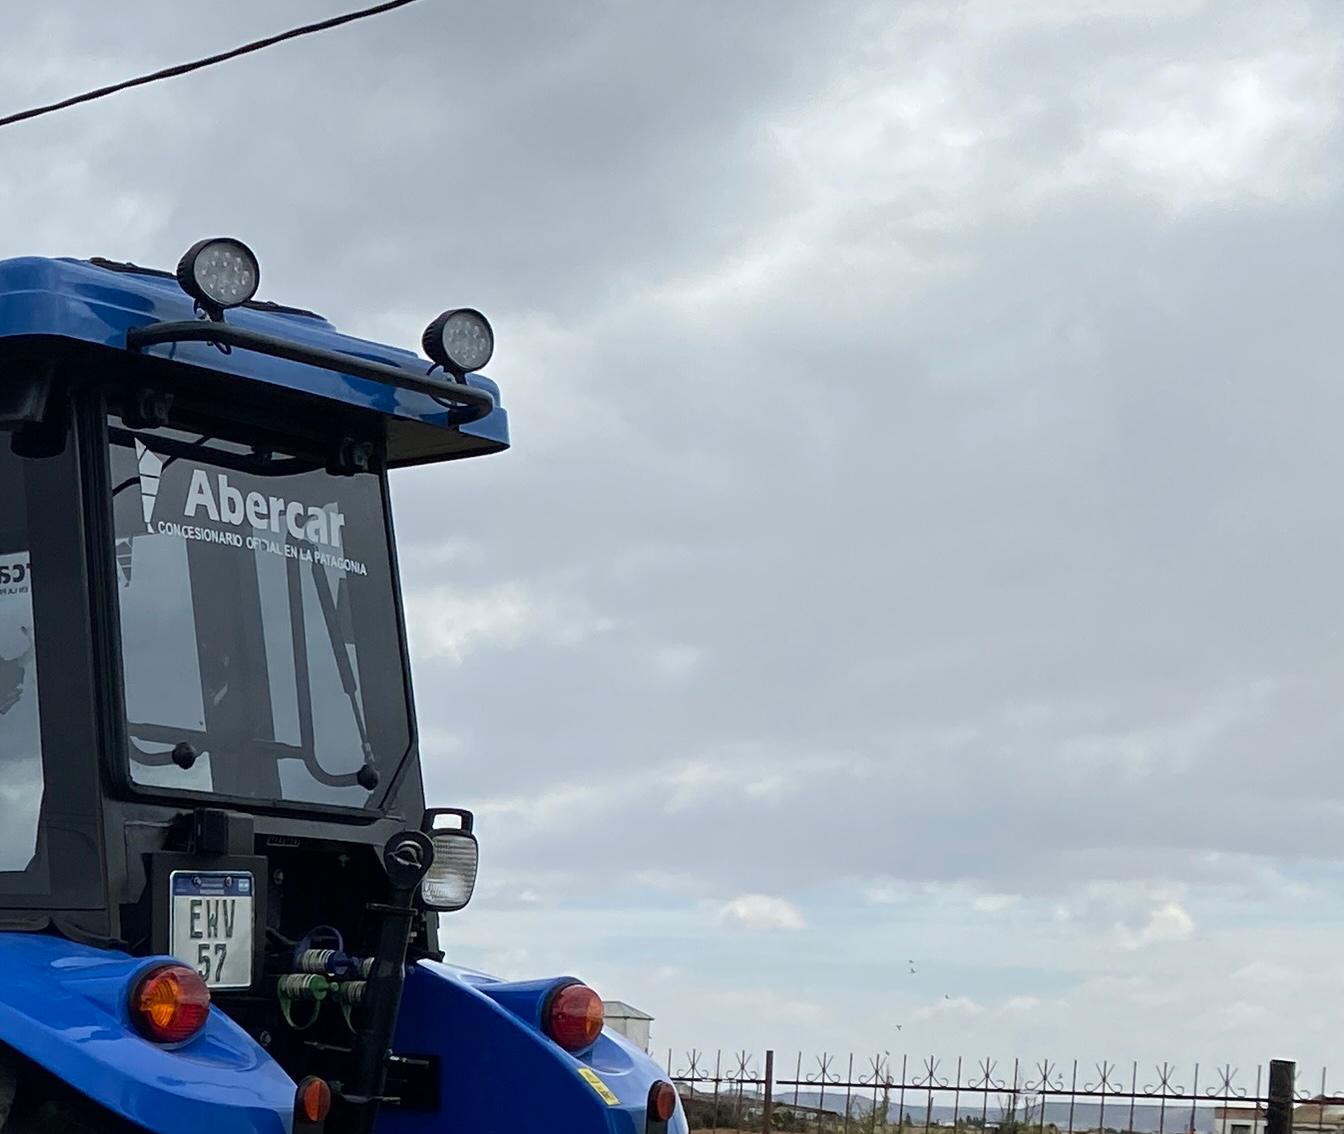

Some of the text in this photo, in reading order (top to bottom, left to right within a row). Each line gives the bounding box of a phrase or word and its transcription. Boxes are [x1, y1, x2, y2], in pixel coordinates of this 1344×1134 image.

[184, 469, 345, 547] Abercar
[158, 521, 368, 577] CONCESIONARIO OFICIAL EN LA PATAGONIA
[190, 899, 236, 939] EWV
[198, 943, 227, 983] 57
